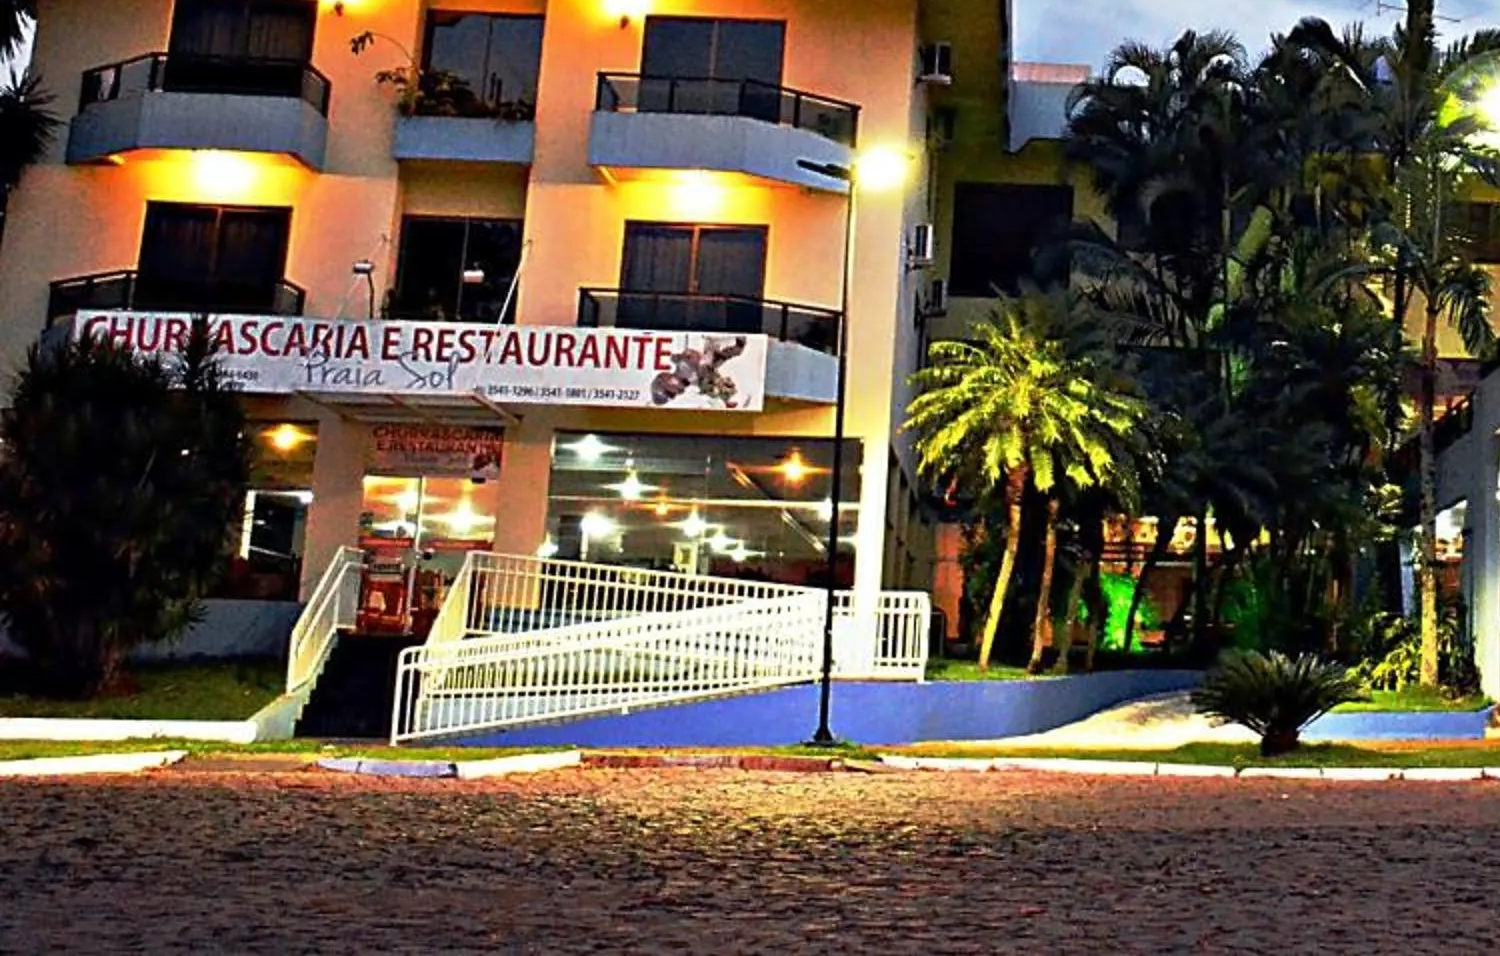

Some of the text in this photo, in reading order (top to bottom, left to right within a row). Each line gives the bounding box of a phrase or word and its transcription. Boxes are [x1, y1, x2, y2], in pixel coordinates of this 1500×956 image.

[83, 315, 673, 372] CHURASCARIA E RESTAURANTE
[302, 349, 460, 389] Praia Sol
